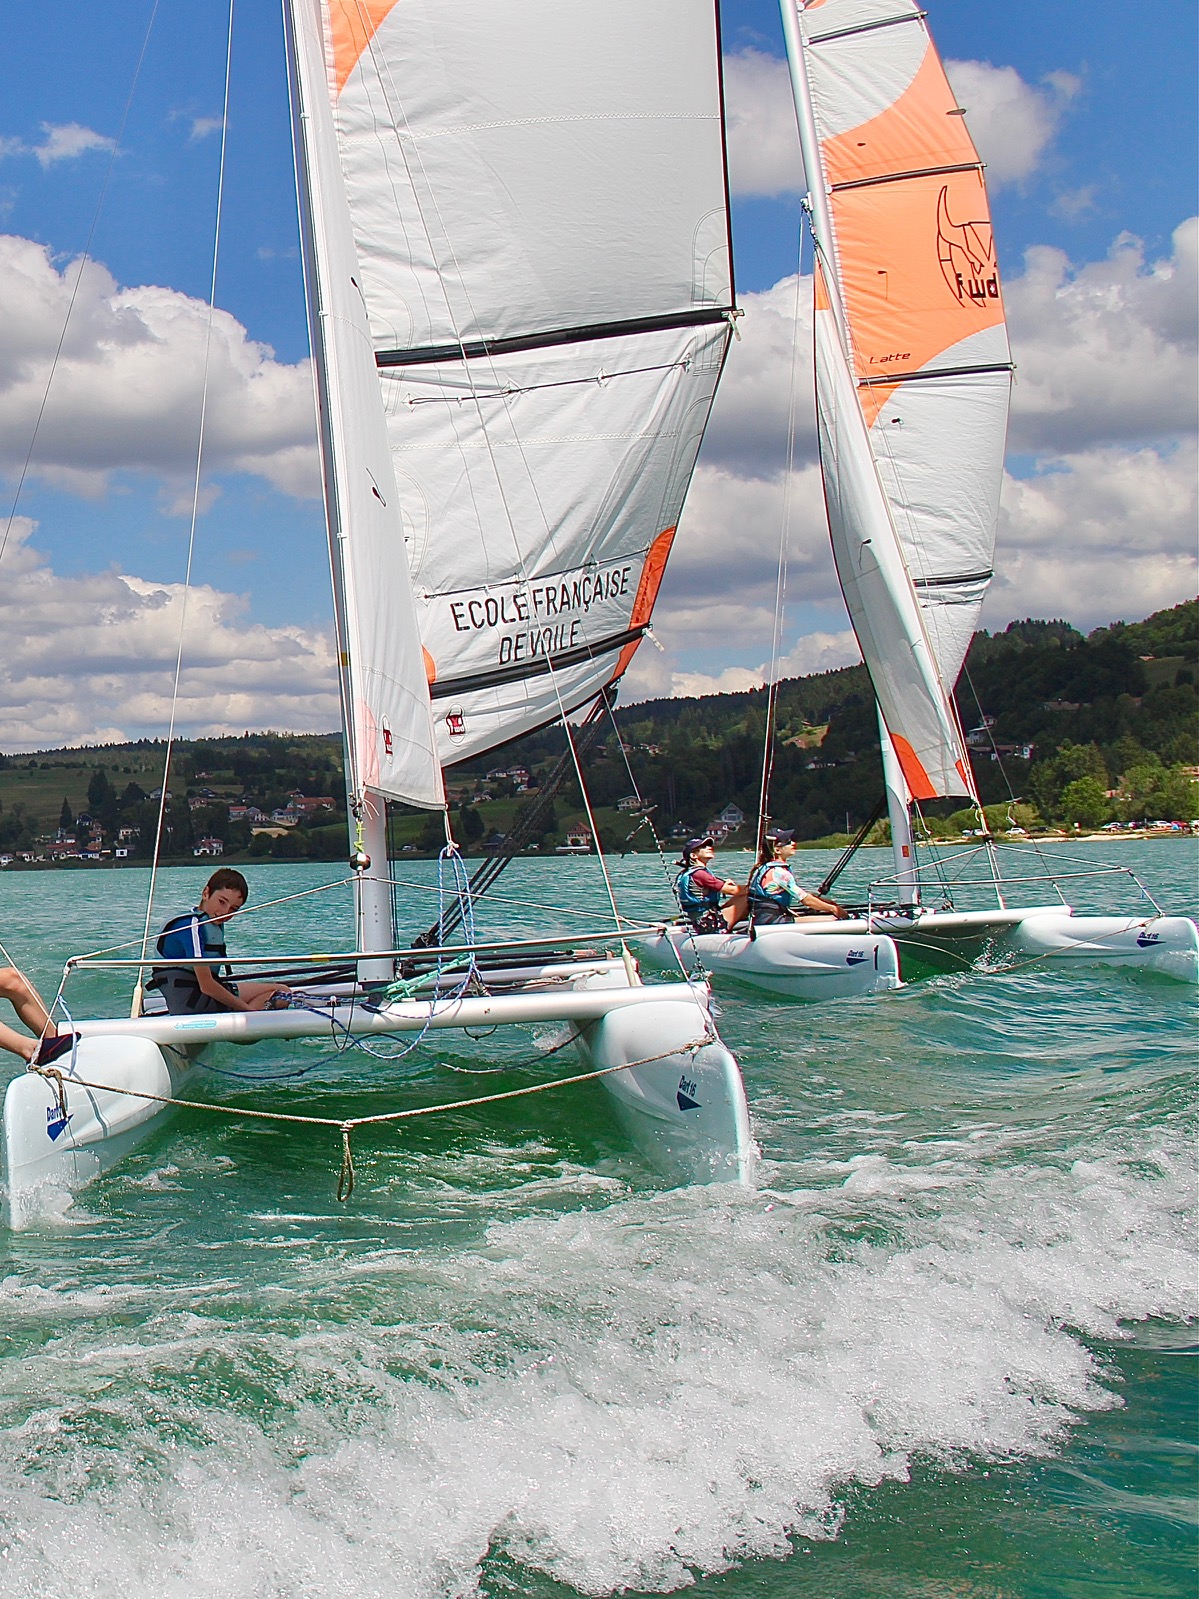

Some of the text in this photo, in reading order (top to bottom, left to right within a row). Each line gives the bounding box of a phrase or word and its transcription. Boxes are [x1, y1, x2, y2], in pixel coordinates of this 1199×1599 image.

[955, 272, 999, 299] fwd
[869, 352, 911, 364] Latte
[450, 592, 530, 631] ECOLE
[533, 566, 632, 619] FRANÇAISE
[499, 619, 582, 665] DE VOILE
